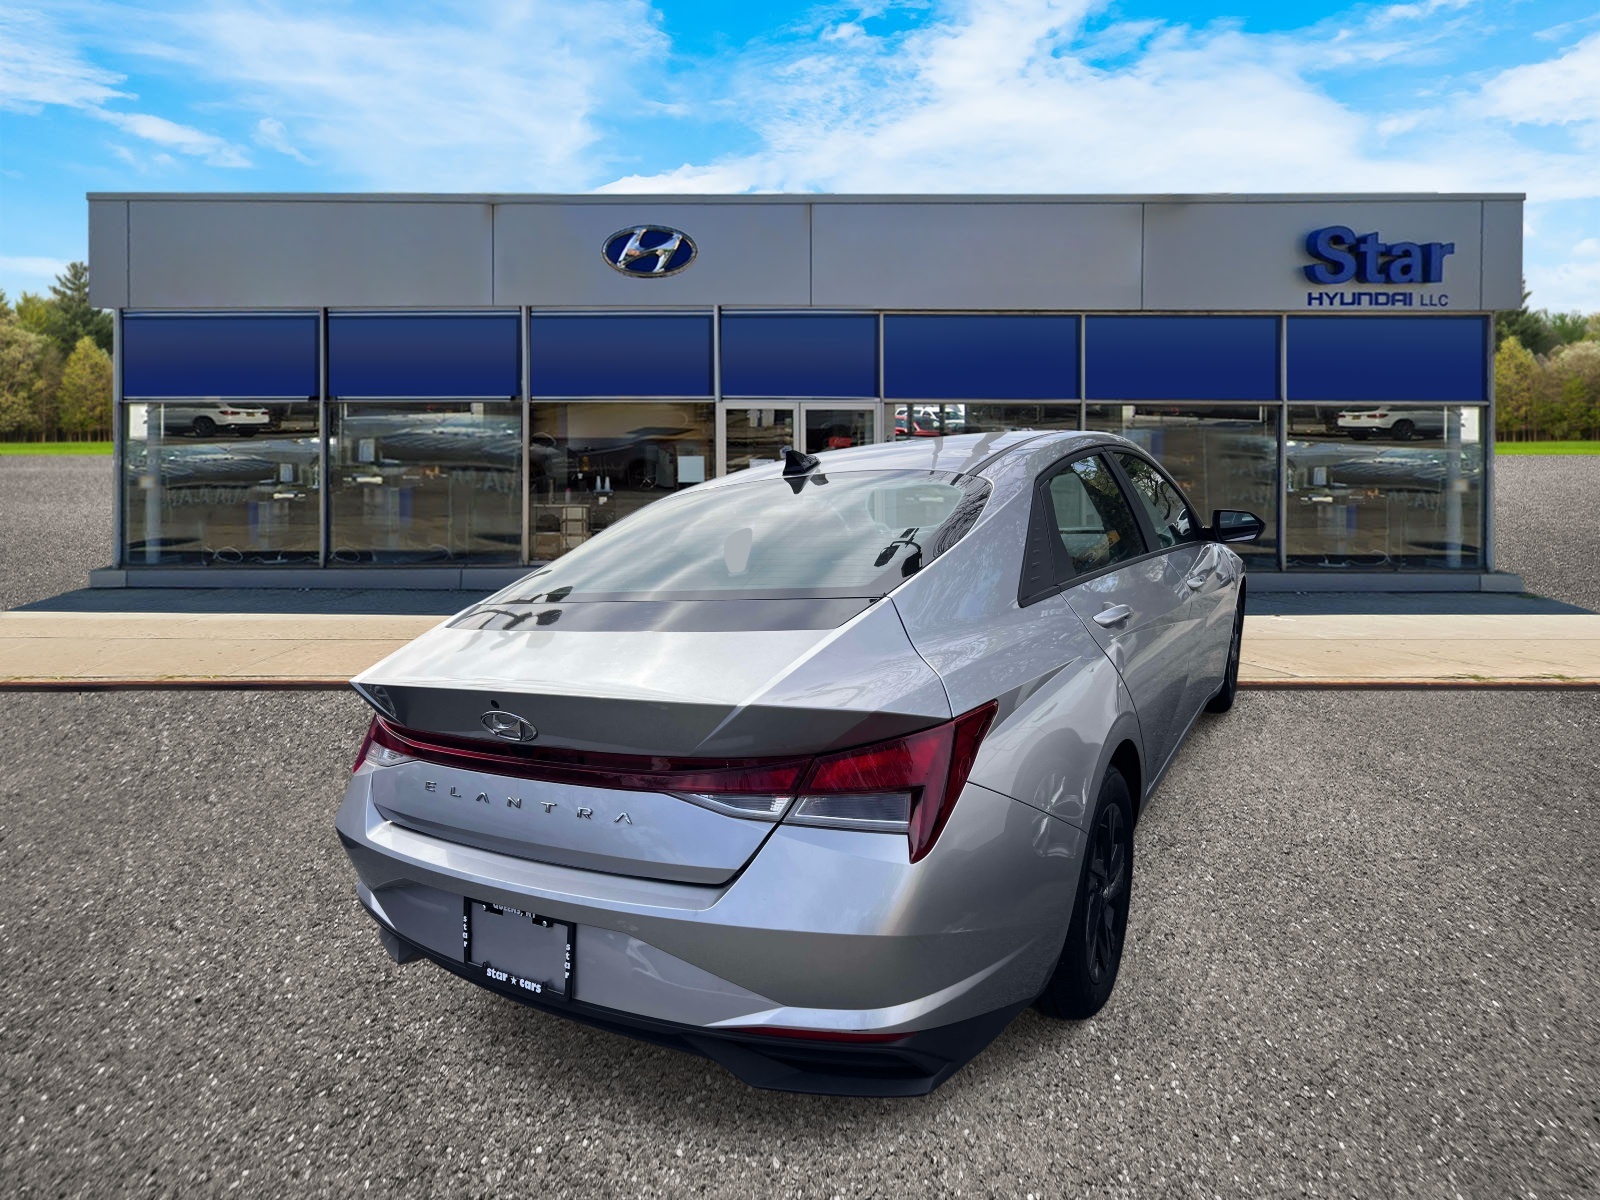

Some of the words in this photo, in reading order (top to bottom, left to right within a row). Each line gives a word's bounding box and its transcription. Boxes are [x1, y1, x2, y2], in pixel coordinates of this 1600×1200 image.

[1303, 225, 1455, 285] Star
[1307, 292, 1413, 306] HYUNDAI
[1420, 294, 1449, 307] LLC
[425, 780, 633, 826] ELANTRA
[486, 967, 508, 982] star
[519, 978, 542, 994] cars
